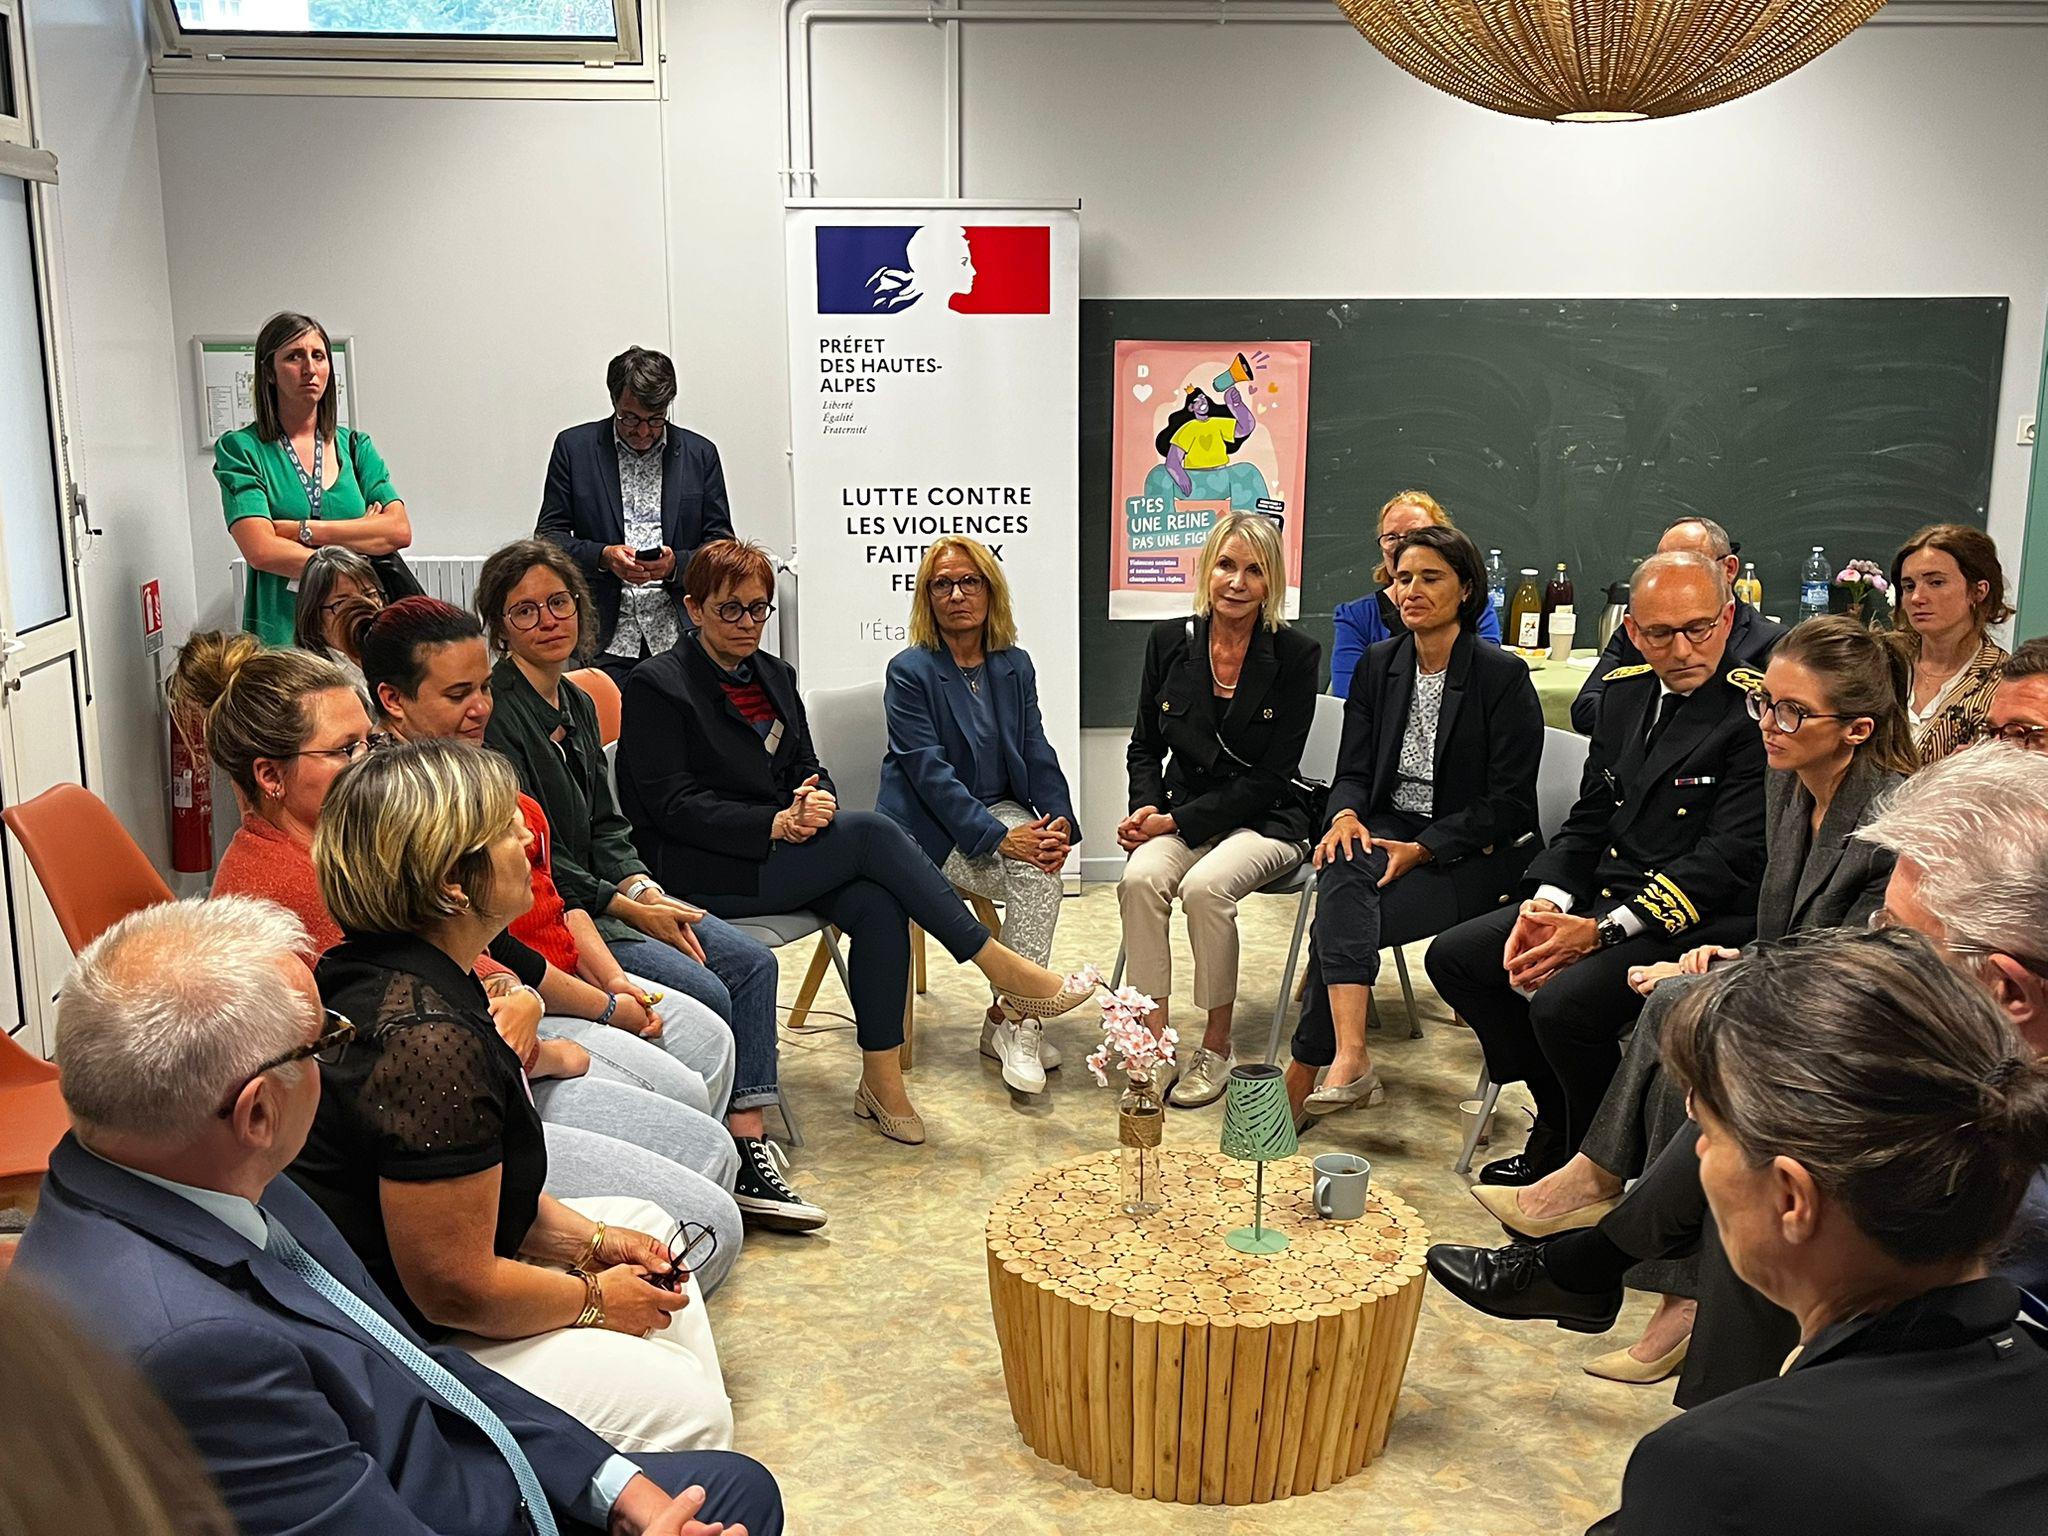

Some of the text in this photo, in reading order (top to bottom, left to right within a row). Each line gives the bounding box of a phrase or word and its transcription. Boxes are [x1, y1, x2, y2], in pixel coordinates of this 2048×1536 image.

[820, 335, 885, 353] PRÉFET
[821, 358, 942, 373] DES HAUTES-
[1137, 364, 1149, 378] D
[820, 378, 875, 392] ALPES
[822, 400, 854, 409] Liberté
[823, 411, 854, 424] Égalité
[823, 424, 869, 434] Fraternité
[842, 487, 1032, 506] LUTTE CONTRE
[1130, 497, 1164, 514] T'ES
[847, 515, 1028, 535] LES VIOLENCES
[1131, 512, 1210, 533] UNE REINE
[1132, 536, 1153, 550] PAS
[1157, 534, 1182, 547] UNE
